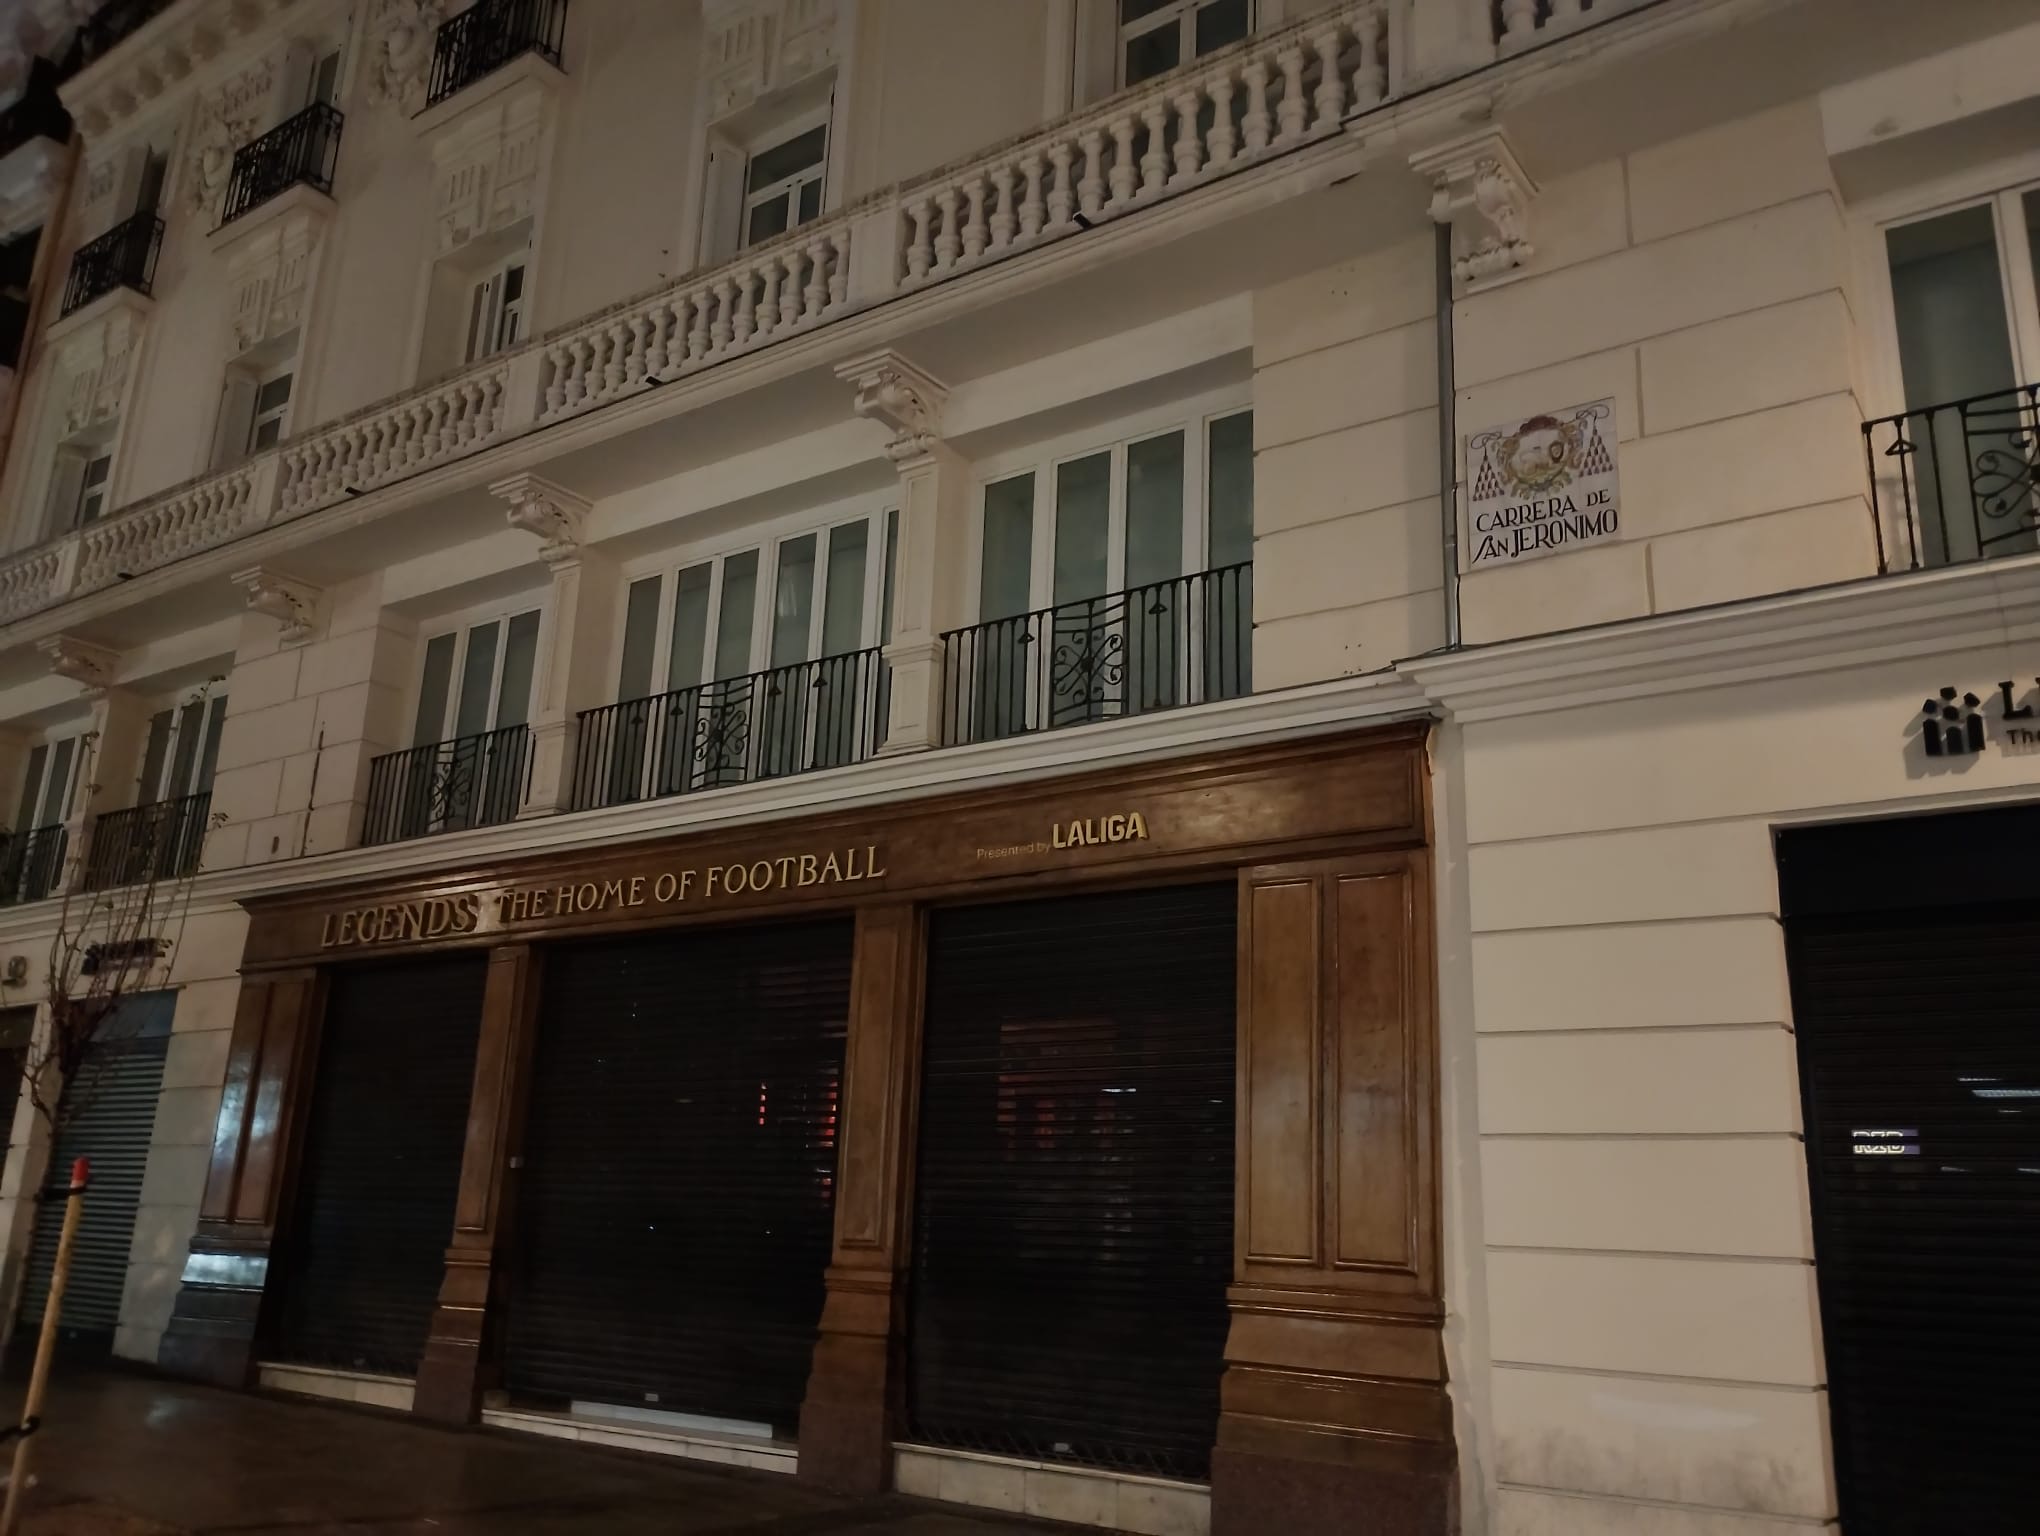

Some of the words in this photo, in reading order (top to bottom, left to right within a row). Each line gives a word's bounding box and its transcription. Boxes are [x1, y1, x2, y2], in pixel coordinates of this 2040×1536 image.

[1476, 496, 1577, 532] CARRERA
[1587, 489, 1610, 507] DE
[1472, 535, 1509, 564] SAN
[1510, 509, 1618, 558] JERONIMO
[977, 842, 1034, 860] Presented
[1052, 812, 1150, 849] LALIGA
[320, 893, 479, 947] LEGENDS
[497, 888, 548, 921] THE
[556, 876, 646, 914] HOME
[654, 870, 697, 902] OF
[704, 845, 886, 897] FOOTBALL
